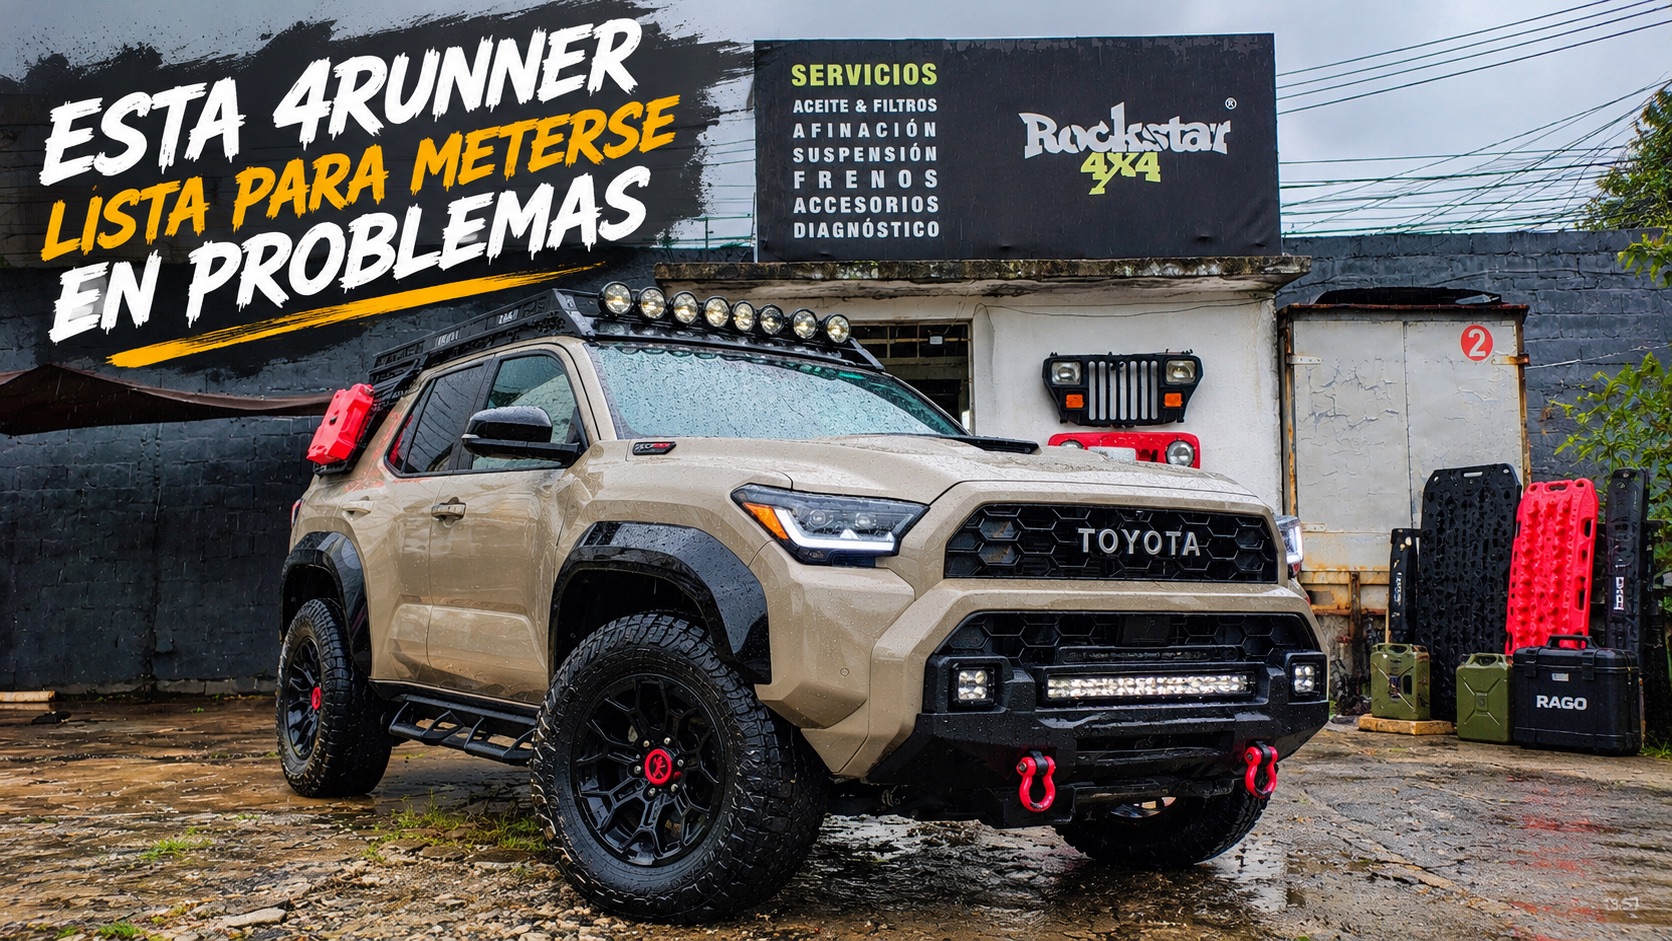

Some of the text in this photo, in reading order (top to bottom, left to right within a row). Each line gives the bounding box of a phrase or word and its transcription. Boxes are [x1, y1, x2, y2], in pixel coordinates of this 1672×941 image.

[791, 62, 938, 86] SERVICIOS
[792, 98, 938, 113] ACEITE & FILTROS
[792, 117, 937, 138] AFINACIÓN
[1018, 101, 1231, 159] Rockstar
[792, 142, 937, 163] SUSPENSIÓN
[793, 169, 939, 189] FRENOS
[793, 195, 939, 214] ACCESORIOS
[793, 217, 940, 239] DIAGNÓSTICO
[1468, 328, 1486, 357] 2
[1077, 527, 1201, 556] TOYOTA
[1536, 694, 1588, 711] RAGO
